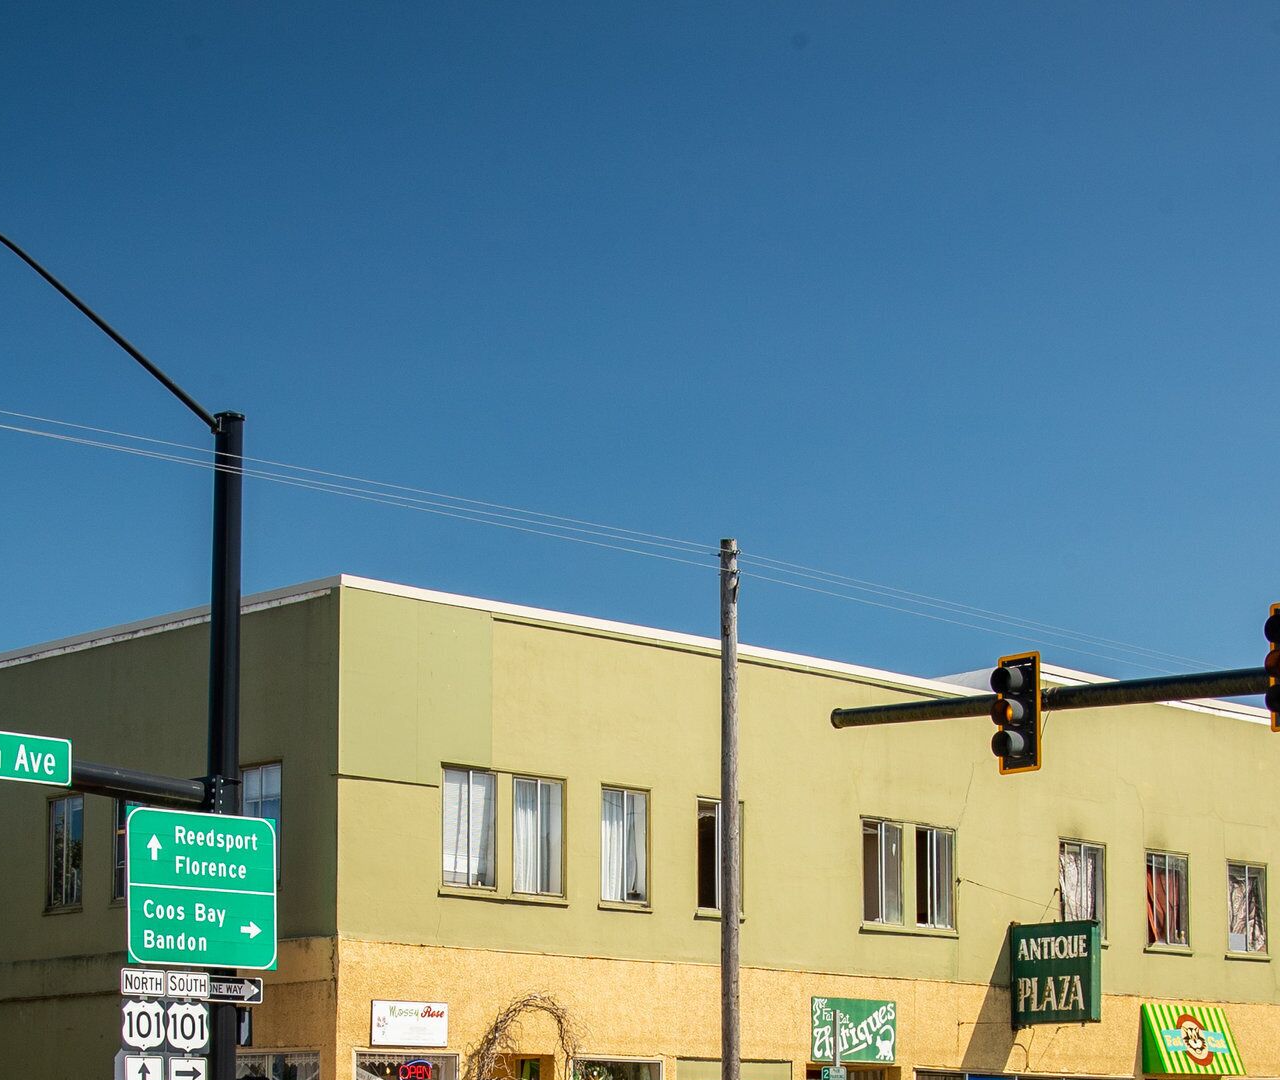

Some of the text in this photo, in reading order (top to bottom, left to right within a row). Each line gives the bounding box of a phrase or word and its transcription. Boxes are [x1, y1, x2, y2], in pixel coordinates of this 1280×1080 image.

[14, 744, 56, 775] Ave
[175, 825, 258, 853] Reedsport
[175, 855, 247, 879] Florence
[143, 899, 226, 927] Coos Bay
[143, 929, 207, 952] Bandon
[1018, 934, 1088, 961] ANTIQUE
[125, 973, 163, 992] NORTH
[169, 975, 207, 993] SOUTH
[226, 985, 243, 994] WAY
[1017, 975, 1085, 1012] PLAZA
[420, 1005, 445, 1018] Rose
[822, 1008, 834, 1021] Fa
[126, 1011, 161, 1038] 101
[171, 1013, 205, 1040] 101
[399, 1065, 432, 1079] OPEN
[823, 1069, 830, 1079] 2
